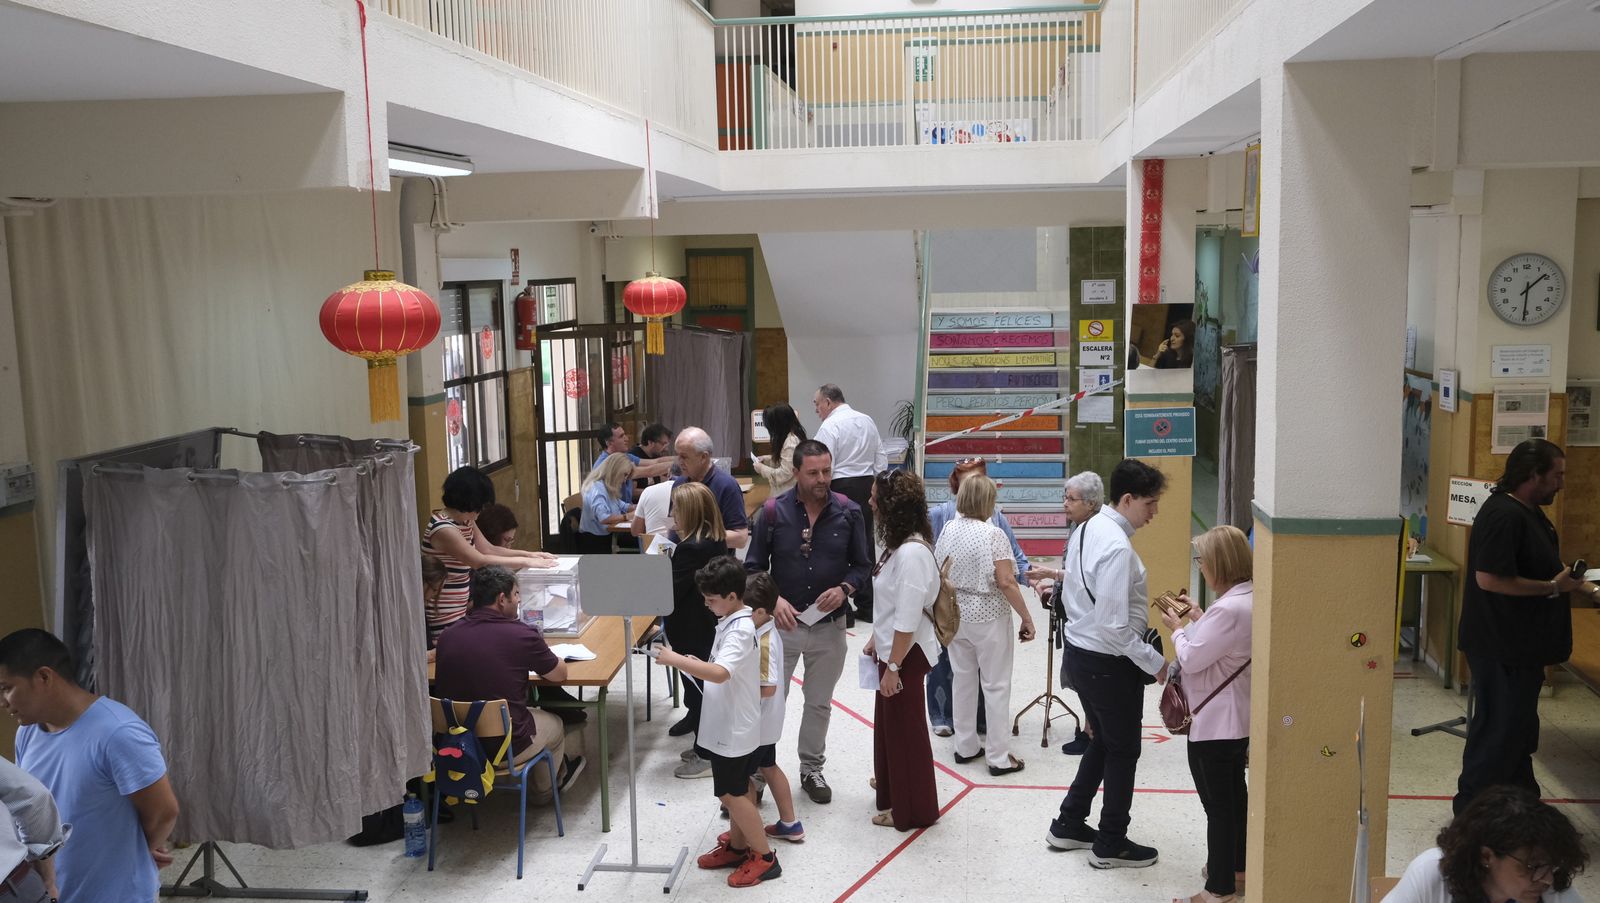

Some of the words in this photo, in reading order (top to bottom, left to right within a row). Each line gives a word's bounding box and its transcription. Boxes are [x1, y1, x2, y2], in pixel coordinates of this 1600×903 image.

[938, 316, 944, 326] Y
[948, 316, 987, 328] SOMOS
[994, 316, 1040, 326] FELICES
[936, 396, 962, 408] PERO
[1451, 494, 1476, 504] MESA
[1028, 515, 1059, 526] FAMILLE
